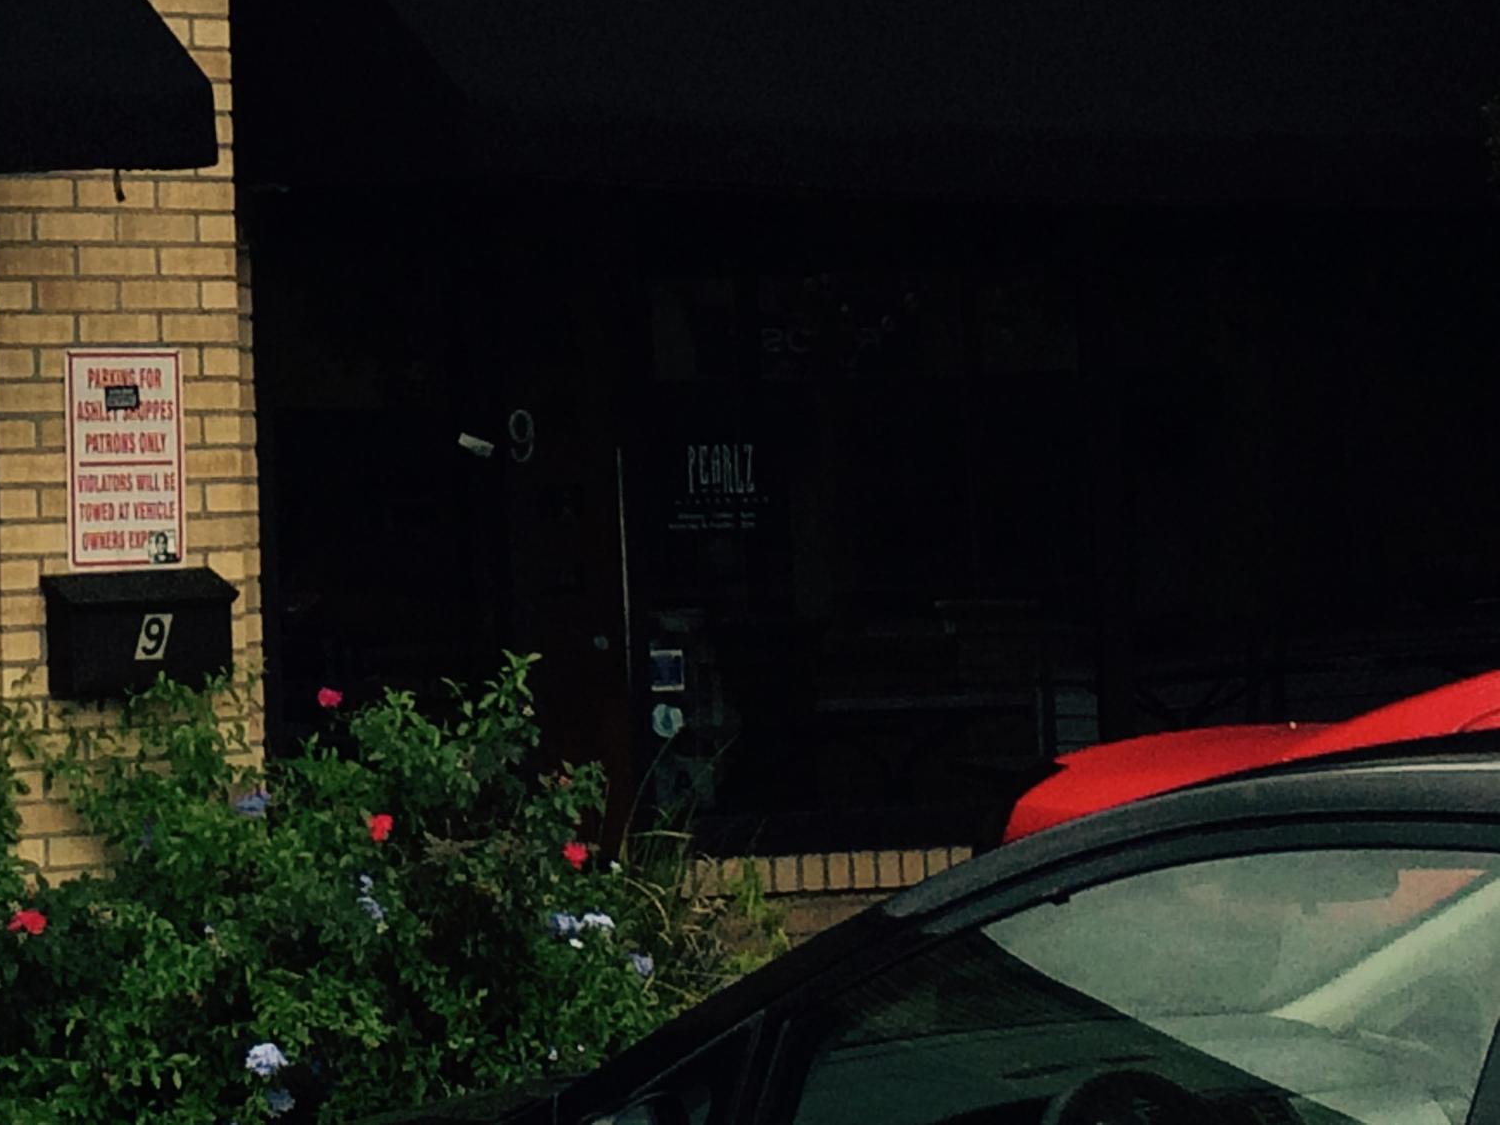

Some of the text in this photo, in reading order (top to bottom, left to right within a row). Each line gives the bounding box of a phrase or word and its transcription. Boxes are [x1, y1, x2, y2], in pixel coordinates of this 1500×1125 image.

[87, 367, 162, 389] PARKING FOR
[85, 432, 166, 453] PATRONS ONLY
[509, 409, 535, 462] 9
[686, 442, 756, 494] PEARLZ
[78, 472, 176, 493] VIOLATORS WILL BE
[79, 500, 175, 522] TOWED AT VEHICLE
[82, 530, 125, 551] OWNERS
[143, 616, 166, 656] 9
